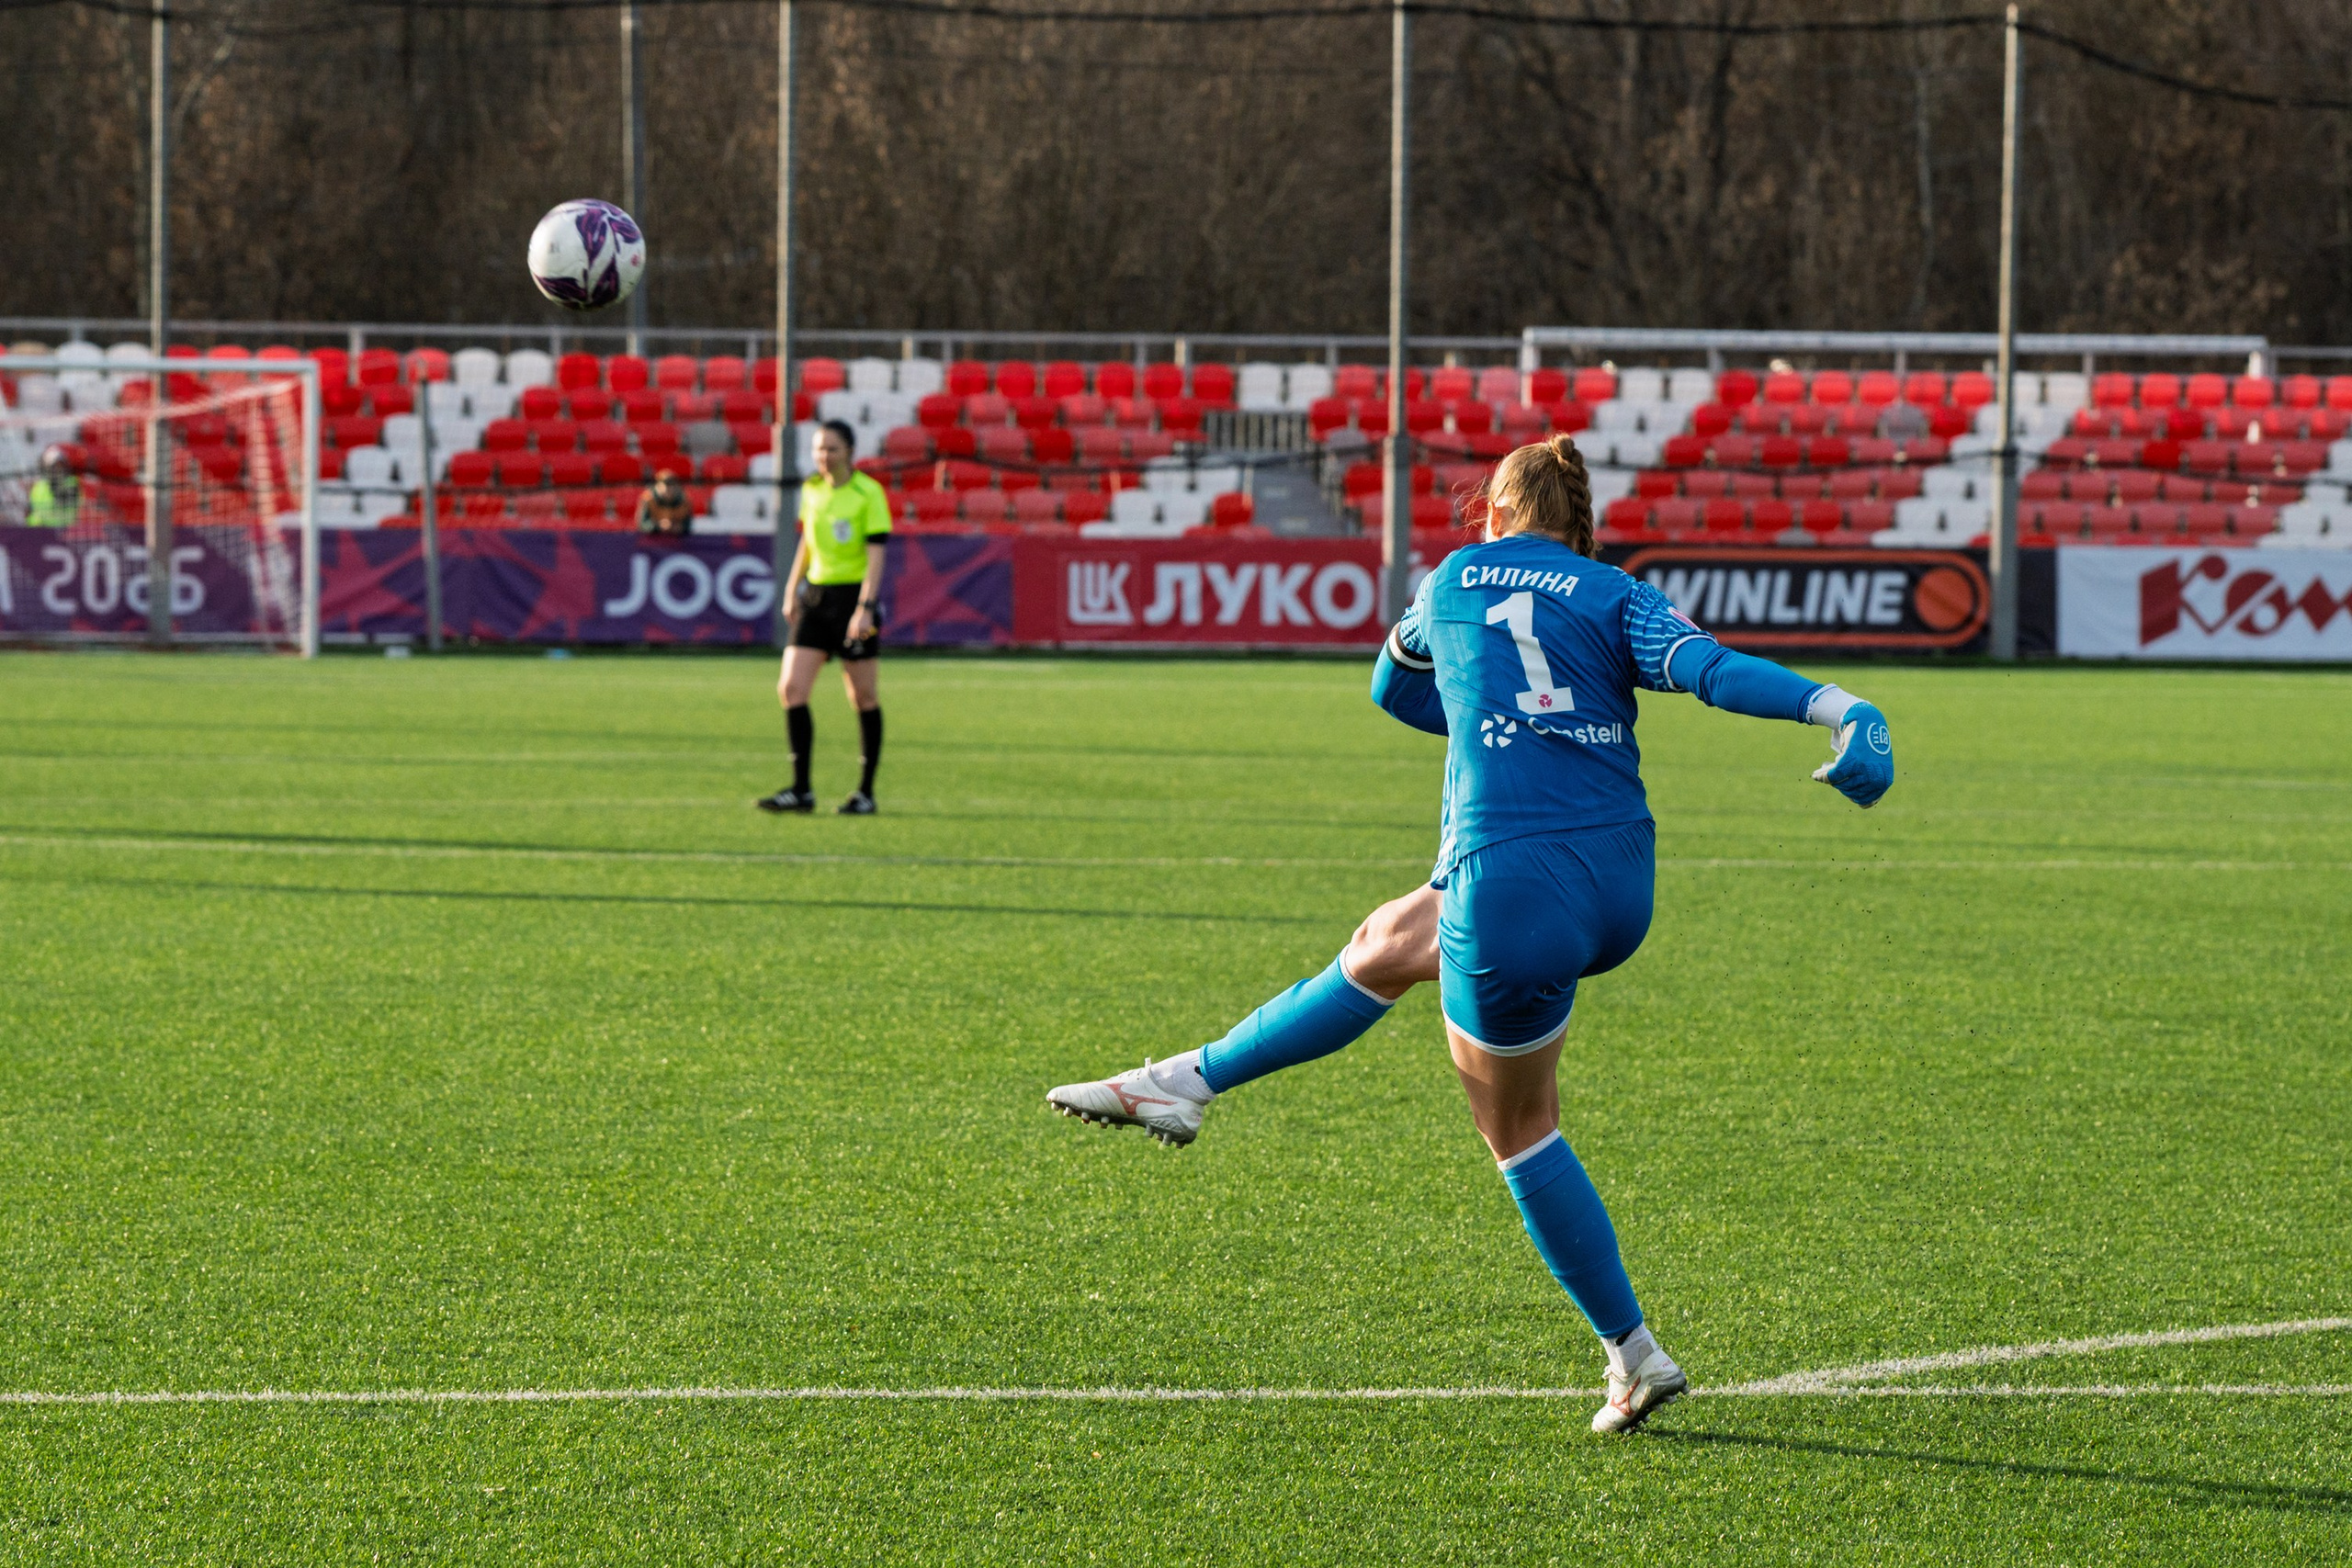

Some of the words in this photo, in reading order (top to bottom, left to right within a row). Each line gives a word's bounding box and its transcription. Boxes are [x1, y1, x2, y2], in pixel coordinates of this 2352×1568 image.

[604, 553, 807, 620] JOG
[1143, 555, 1430, 629] ЛУКО
[1461, 565, 1580, 597] СИЛИНА
[1646, 568, 1908, 626] WINLINE
[1486, 591, 1576, 716] 1
[1527, 716, 1622, 745] Cstell
